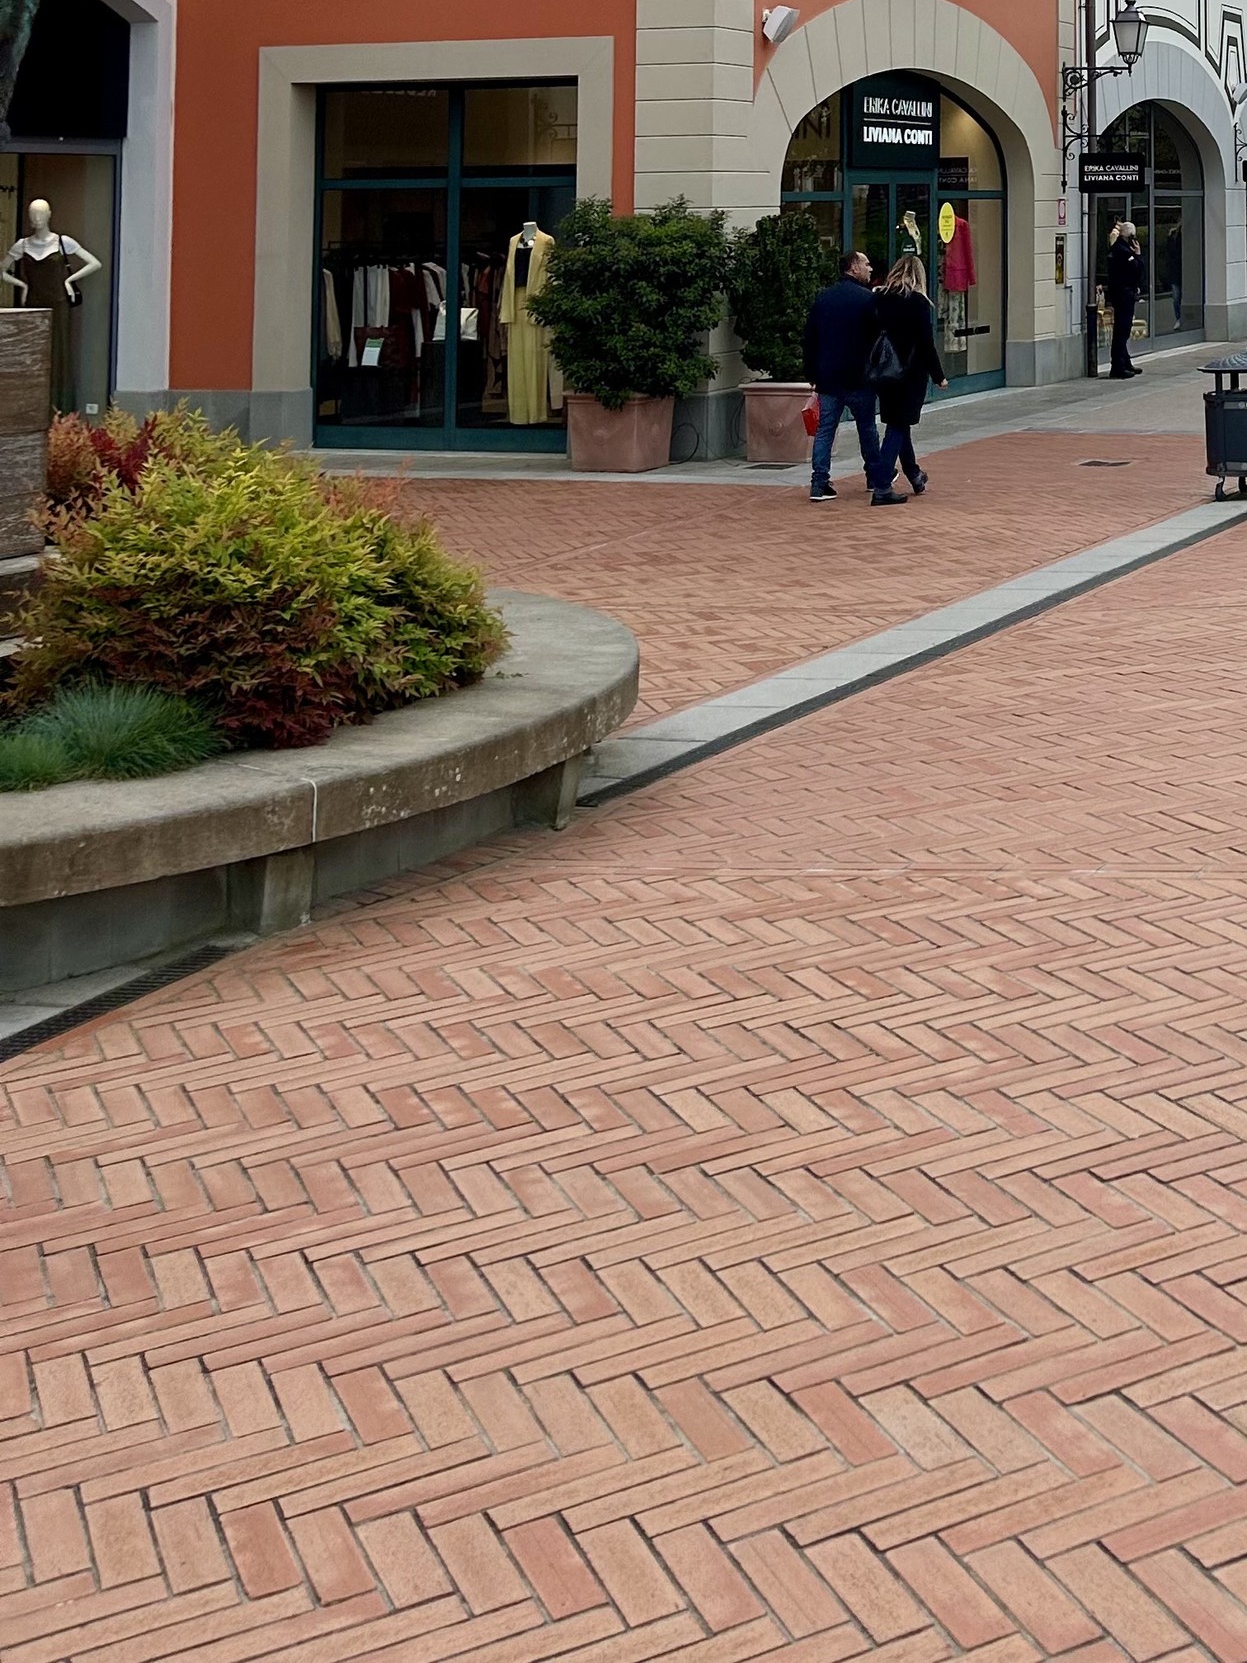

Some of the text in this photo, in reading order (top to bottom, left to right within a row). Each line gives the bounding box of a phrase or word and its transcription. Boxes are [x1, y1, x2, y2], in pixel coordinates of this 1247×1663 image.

[864, 96, 933, 117] ERIKA CAVALLINI
[863, 126, 933, 145] LIVIANA CONTI
